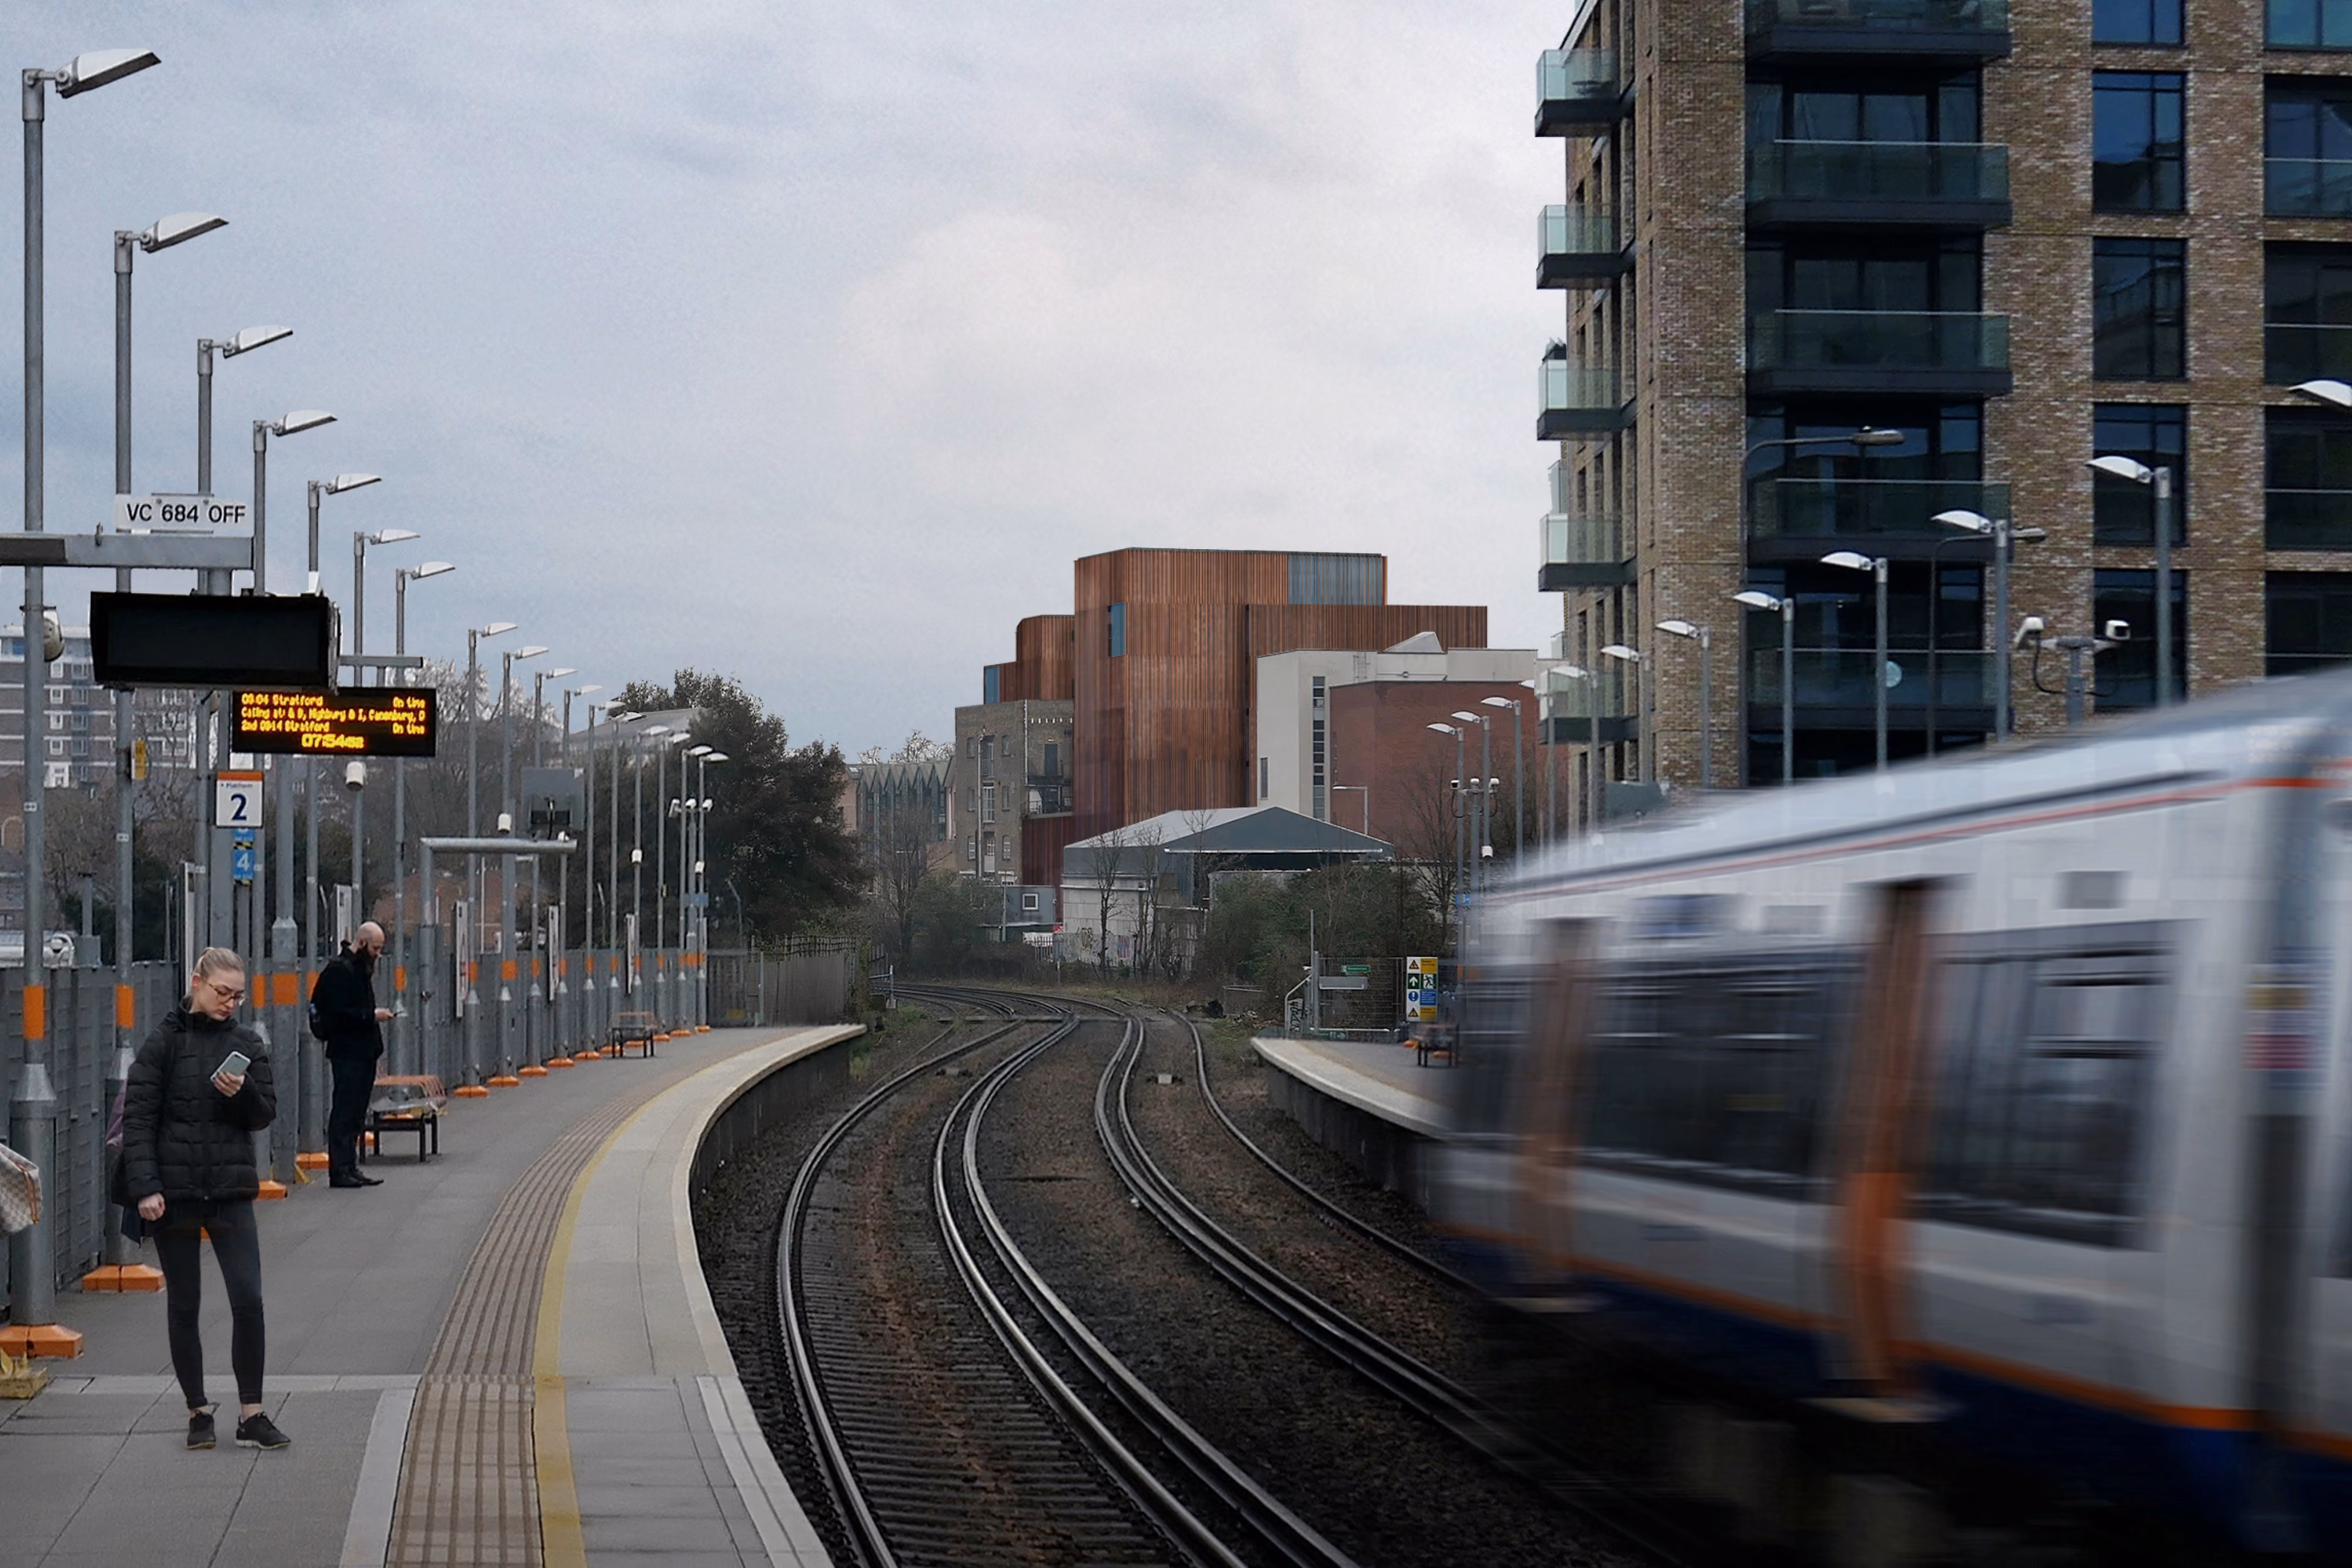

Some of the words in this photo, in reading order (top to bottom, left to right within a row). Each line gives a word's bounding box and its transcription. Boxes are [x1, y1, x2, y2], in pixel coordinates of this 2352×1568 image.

[126, 503, 152, 521] VC
[161, 504, 199, 523] 684
[208, 504, 246, 523] OFF
[272, 694, 323, 706] Stratford
[285, 720, 330, 732] Stratford
[230, 793, 247, 821] 2
[237, 852, 250, 871] 4
